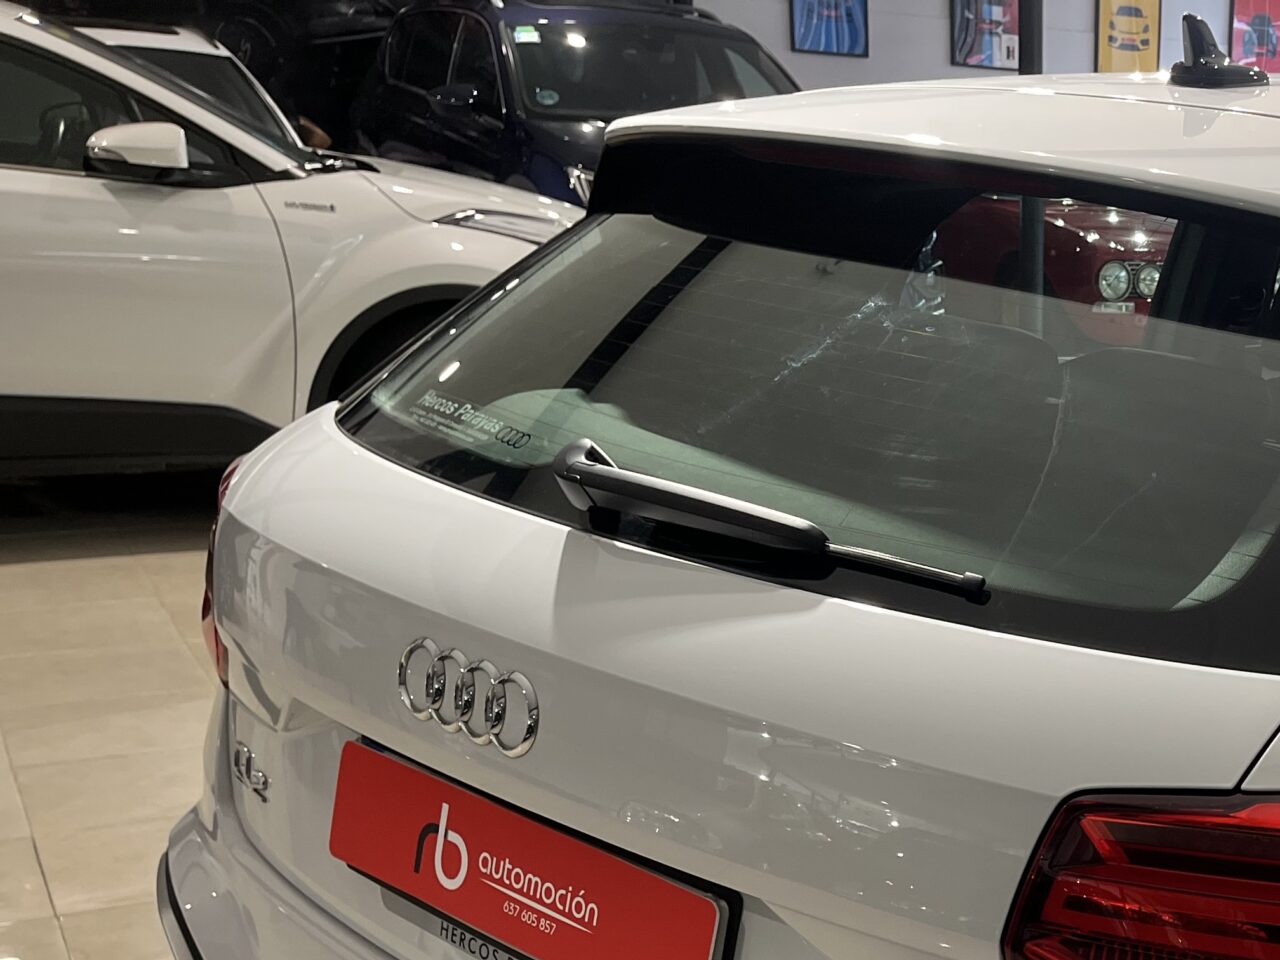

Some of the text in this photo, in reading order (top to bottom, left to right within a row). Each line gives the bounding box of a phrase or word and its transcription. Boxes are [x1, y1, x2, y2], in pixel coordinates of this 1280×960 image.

[454, 404, 504, 433] Parayas
[478, 851, 599, 927] automoción
[503, 901, 557, 935] 637 605 857
